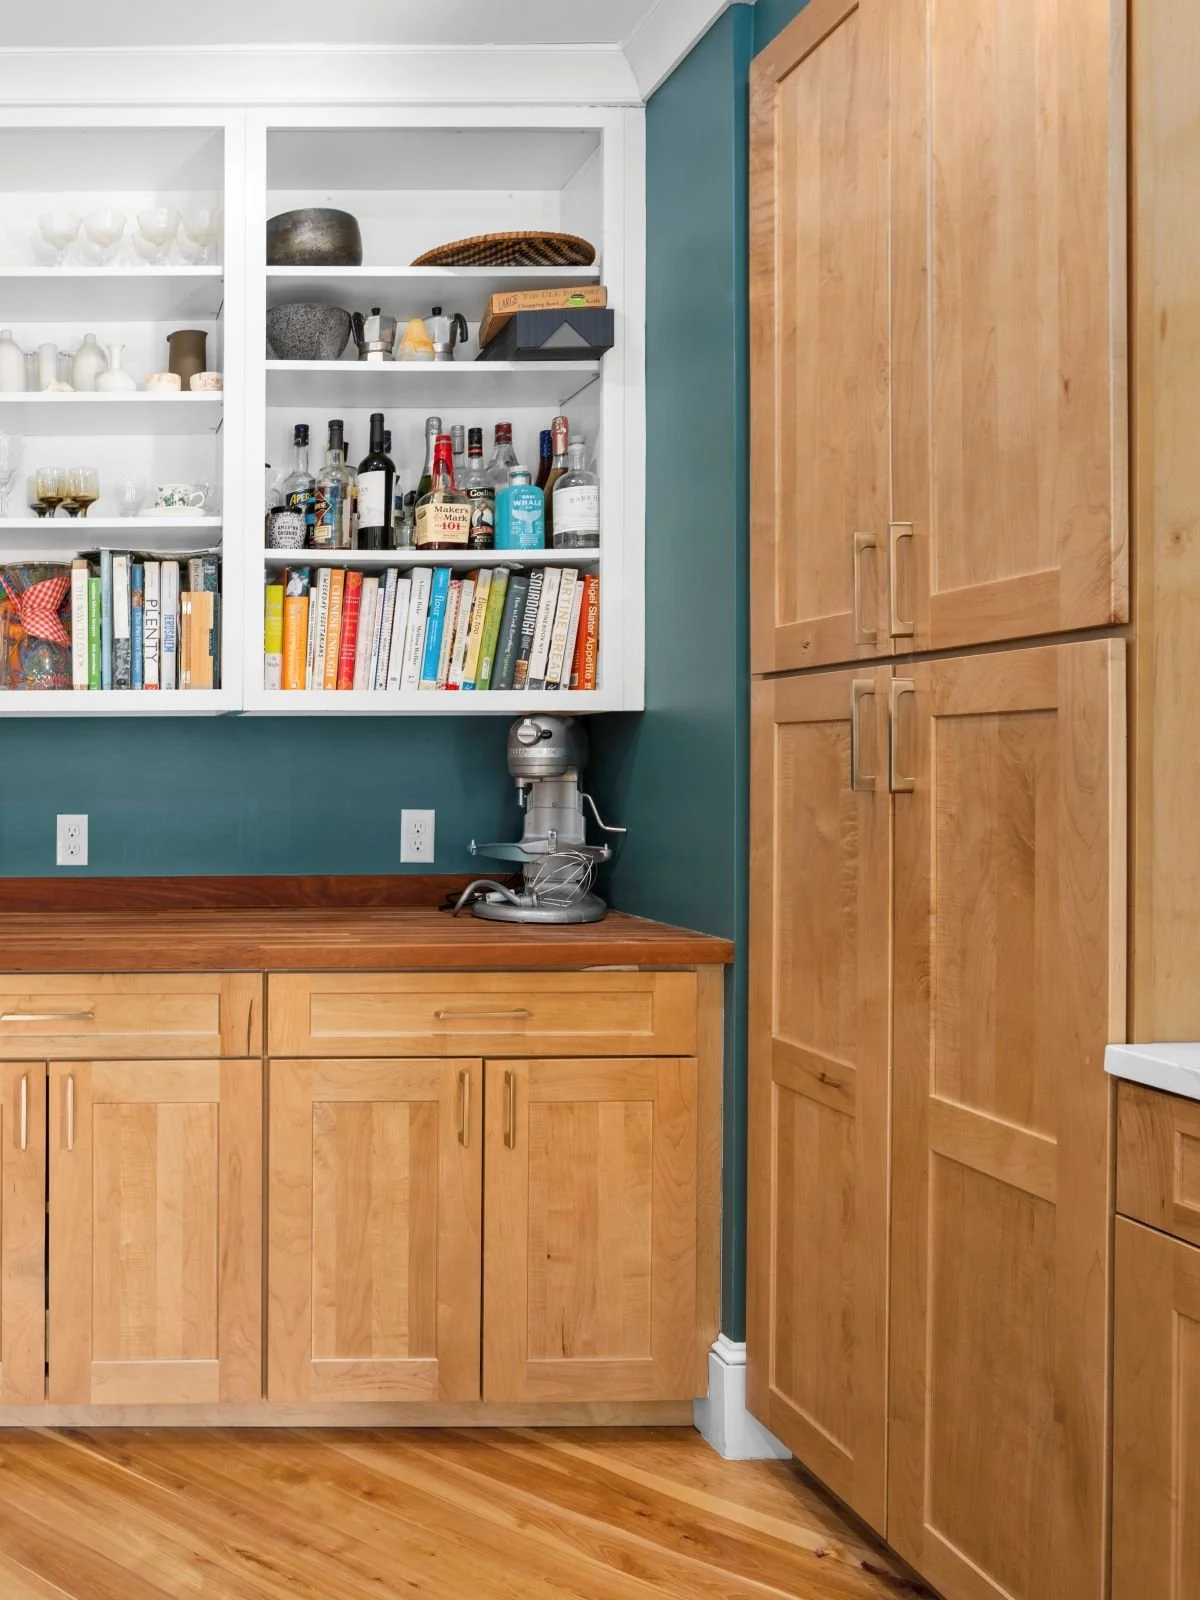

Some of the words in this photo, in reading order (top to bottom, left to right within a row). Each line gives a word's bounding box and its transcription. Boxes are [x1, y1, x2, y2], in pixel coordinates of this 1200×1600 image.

[434, 506, 469, 514] Maker's
[513, 499, 542, 507] WHALE
[442, 522, 461, 530] 101
[444, 514, 468, 522] Mark
[321, 578, 329, 610] WEEKDAY
[433, 594, 444, 617] flour
[513, 597, 521, 609] How
[521, 572, 544, 635] SOURDOUGH
[556, 570, 576, 629] TARTINE
[588, 579, 599, 604] Nigel
[329, 584, 340, 628] CHINESE
[542, 600, 551, 625] TARTINE
[586, 606, 597, 634] Slater
[145, 599, 158, 663] PLENTY
[163, 614, 175, 652] JERUSALEM
[318, 612, 327, 658] VEGETARIANS
[473, 622, 481, 635] too
[510, 615, 518, 628] Cook
[326, 632, 338, 677] ENOUGH
[549, 633, 567, 680] BREAD
[584, 636, 596, 680] Appetite
